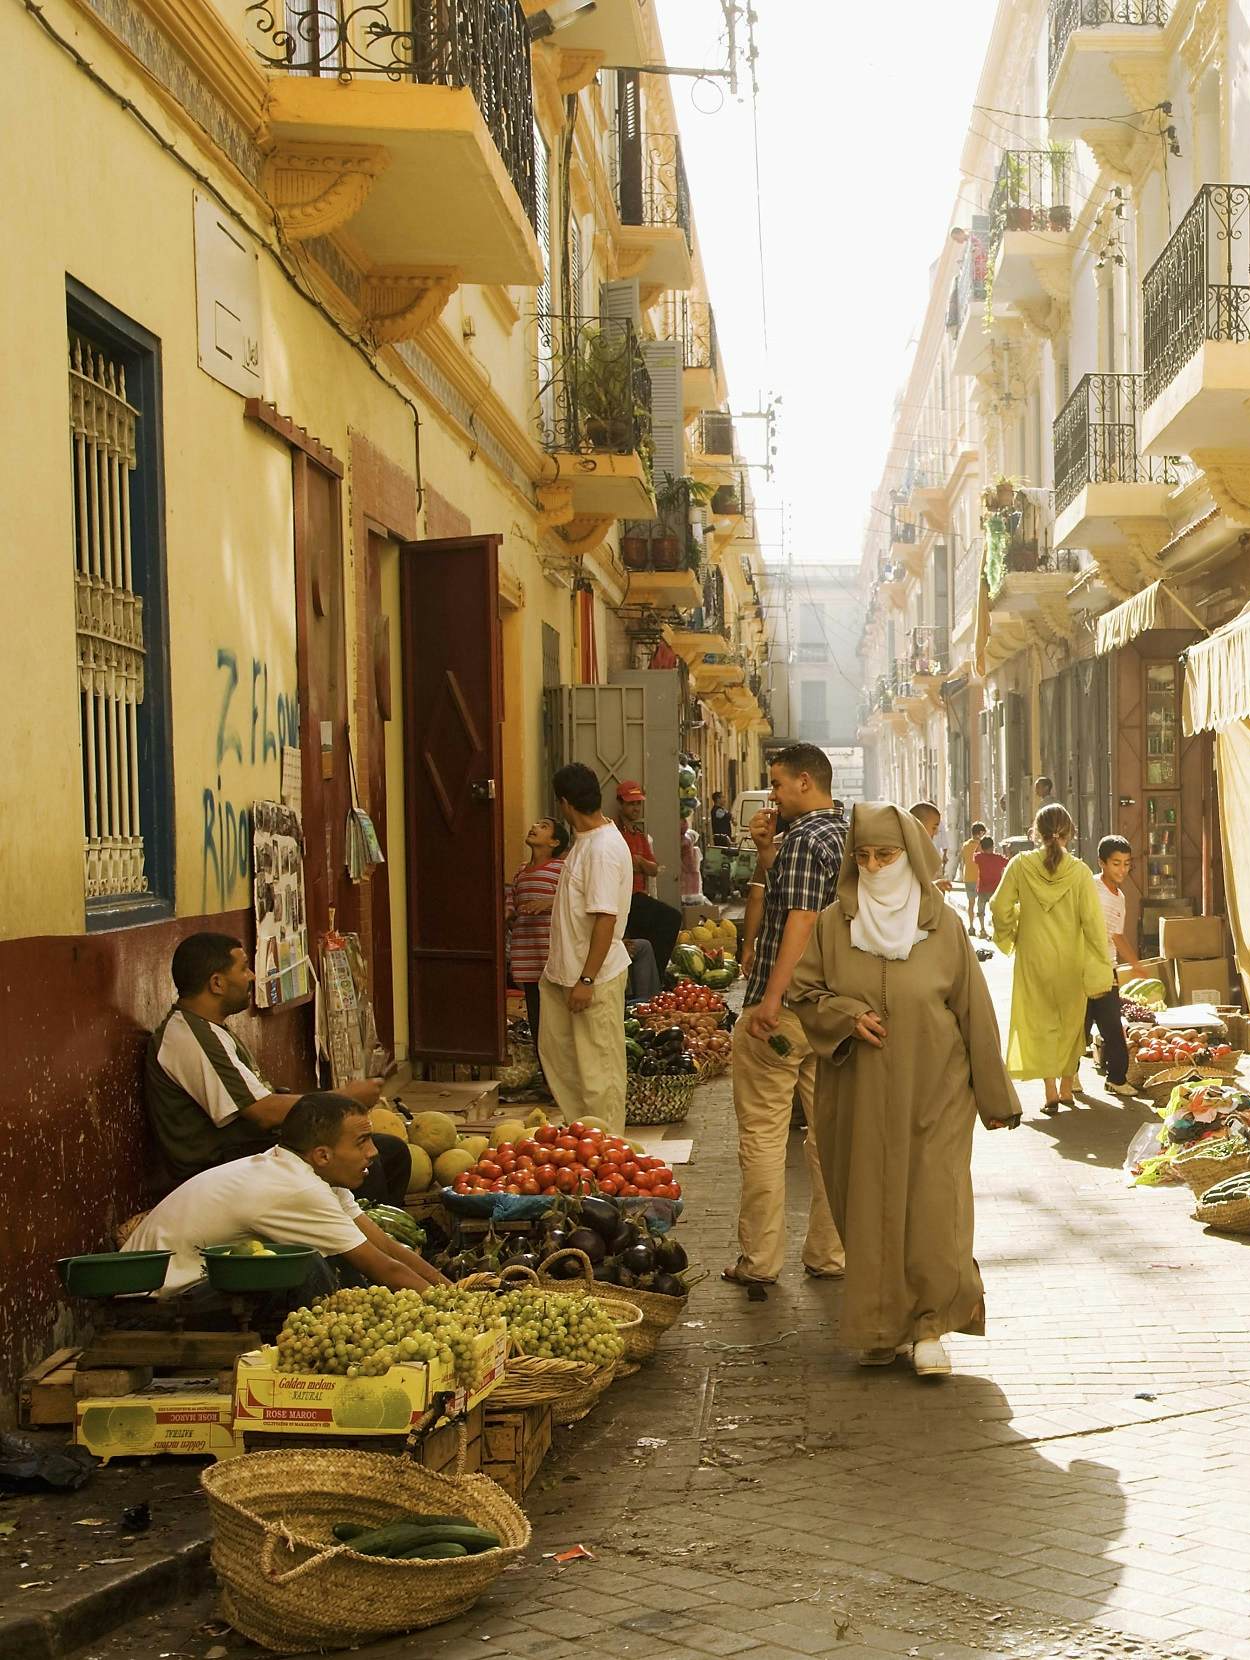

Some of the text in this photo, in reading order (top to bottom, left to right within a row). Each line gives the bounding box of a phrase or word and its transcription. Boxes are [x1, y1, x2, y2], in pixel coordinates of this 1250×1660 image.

[278, 1377, 336, 1391] Golden melons
[291, 1391, 324, 1401] NATURAL
[170, 1413, 217, 1422] ROSE MAROC
[265, 1409, 318, 1420] ROSE MAROC
